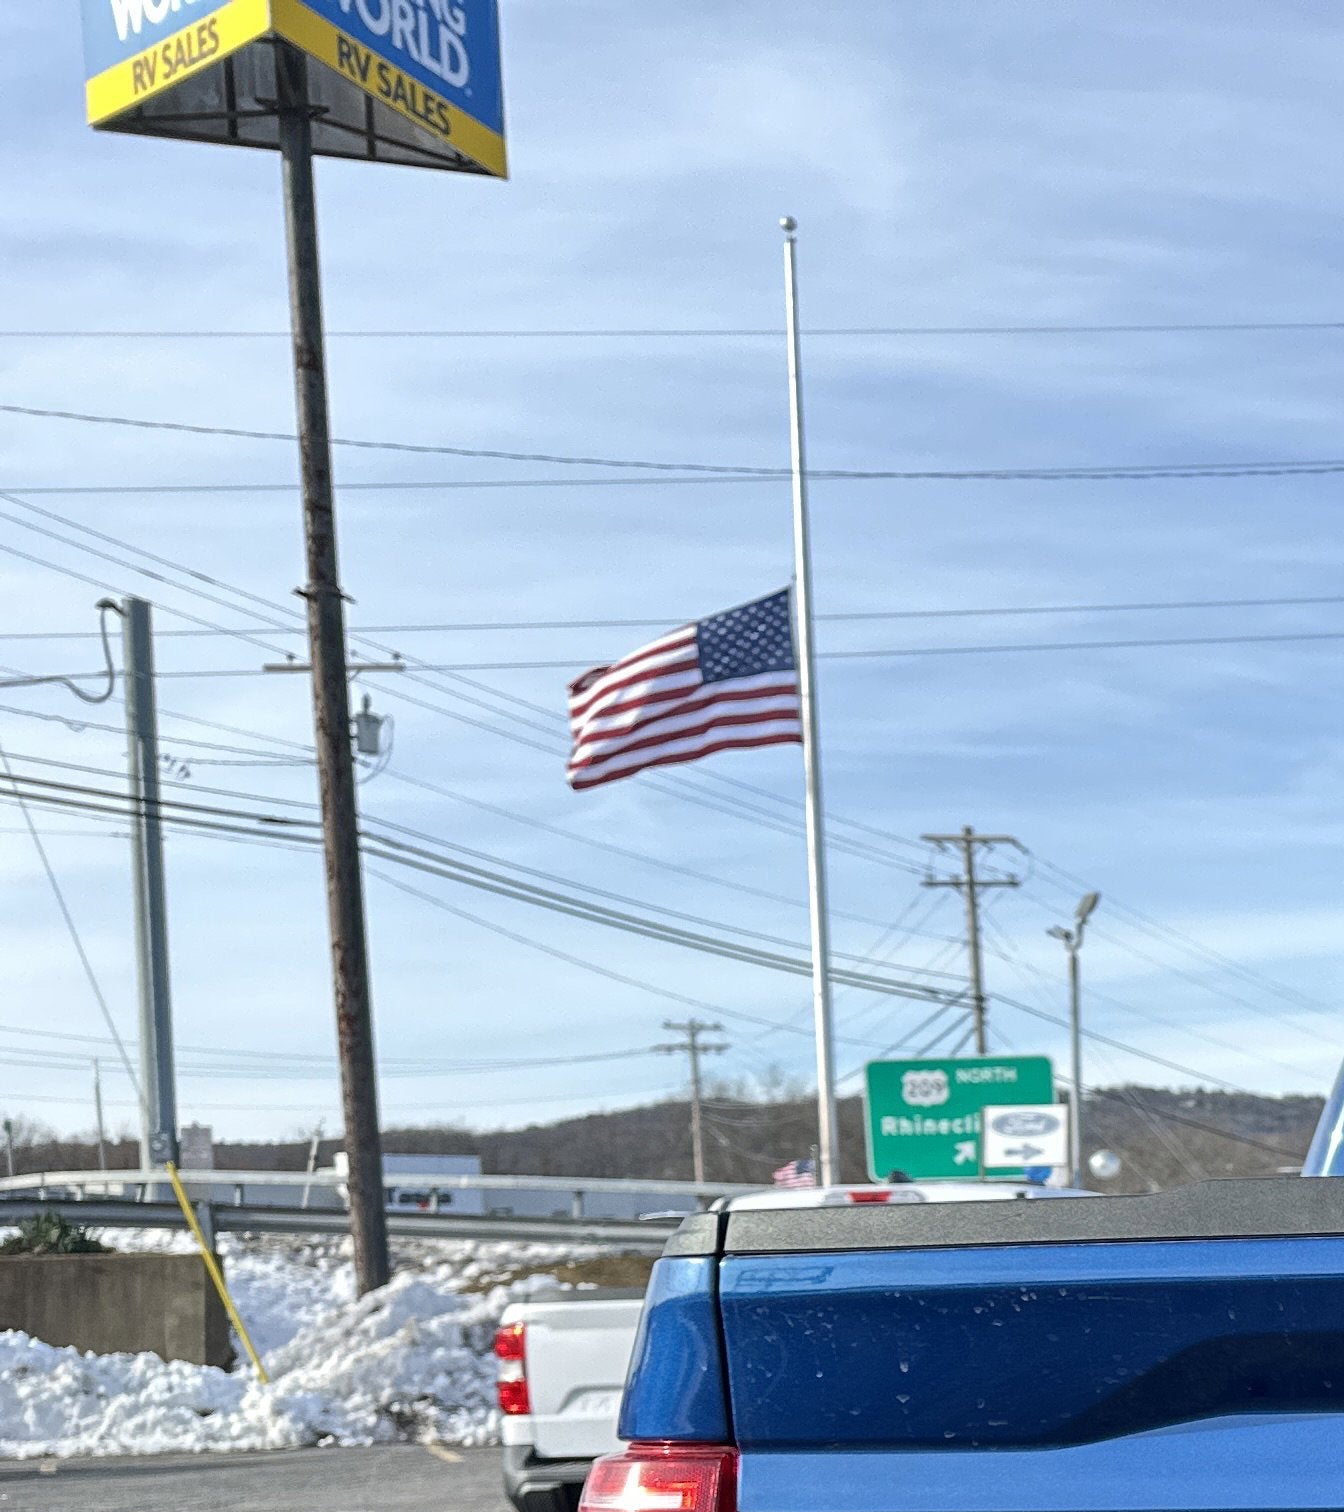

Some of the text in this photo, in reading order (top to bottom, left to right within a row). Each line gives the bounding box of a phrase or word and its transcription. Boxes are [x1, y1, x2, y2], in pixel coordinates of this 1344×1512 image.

[132, 51, 157, 95] RV
[161, 17, 220, 79] SALES
[339, 0, 469, 88] ORLD
[336, 34, 450, 135] RV SALES
[955, 1066, 1018, 1084] NORTH
[881, 1113, 981, 1136] Rhinecli
